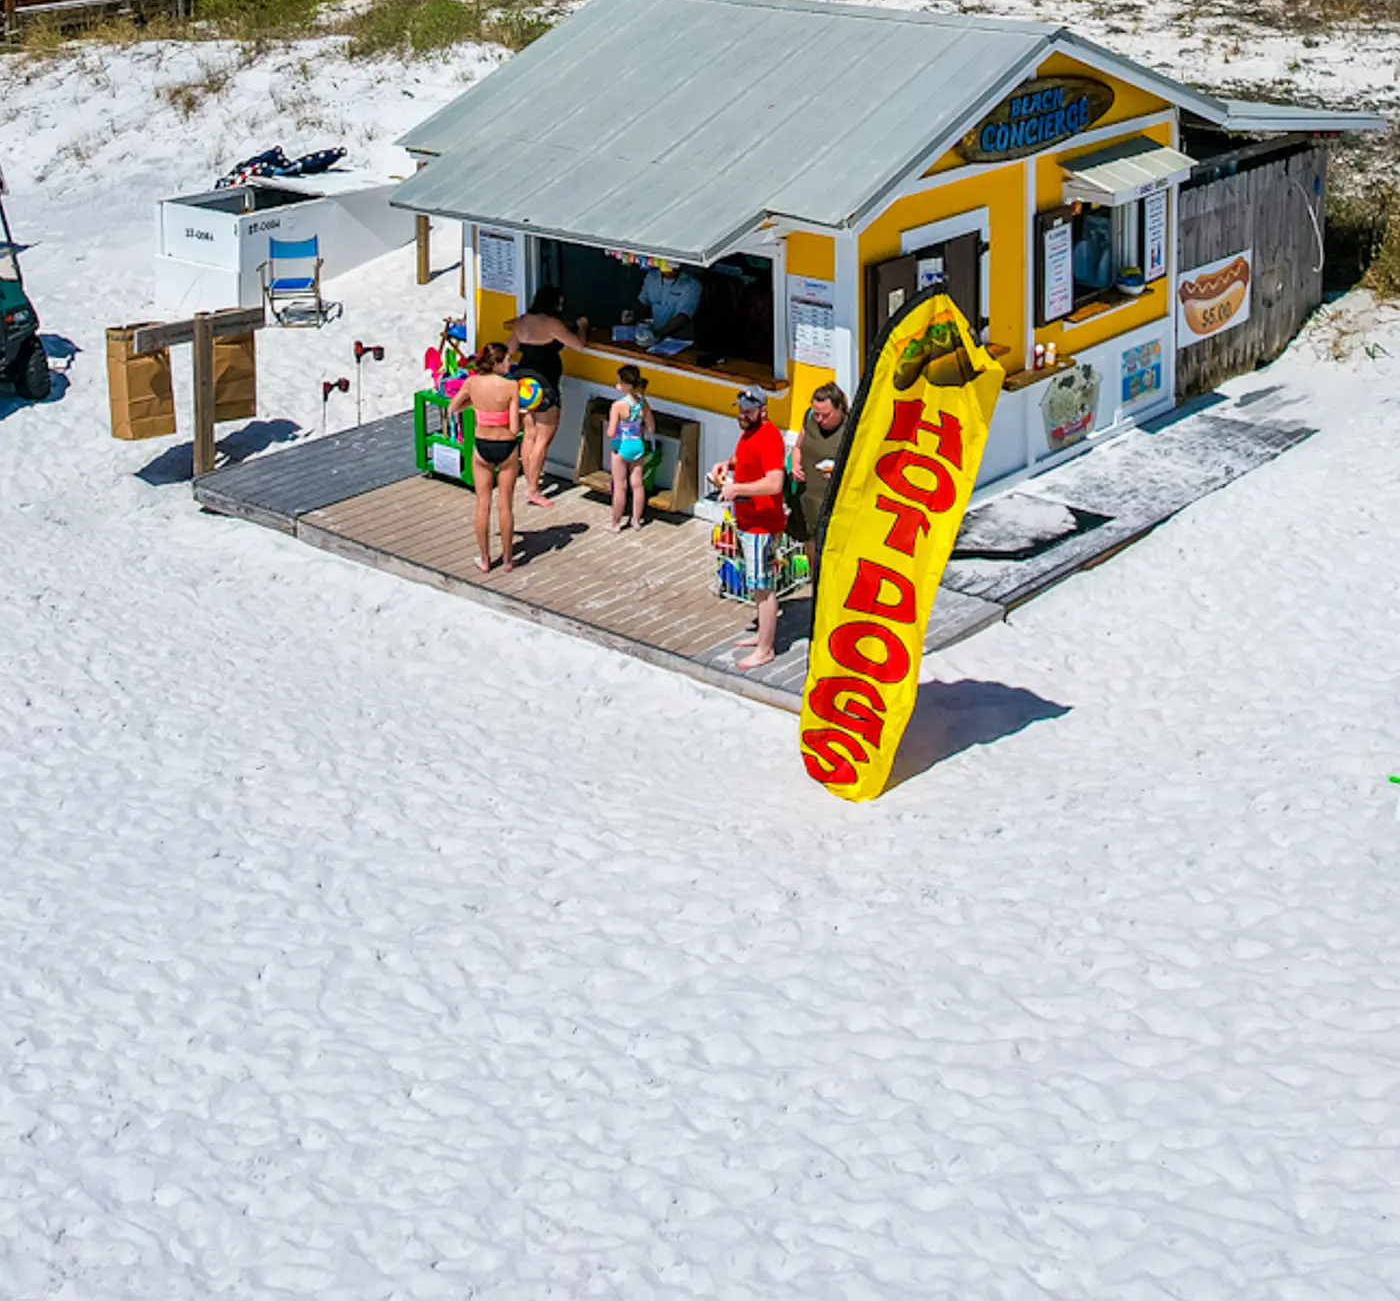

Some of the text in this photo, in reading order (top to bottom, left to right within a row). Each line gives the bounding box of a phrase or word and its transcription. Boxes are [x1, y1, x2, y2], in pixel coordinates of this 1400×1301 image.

[1010, 86, 1065, 118] BEACH
[801, 399, 964, 785] HOT DOGS
